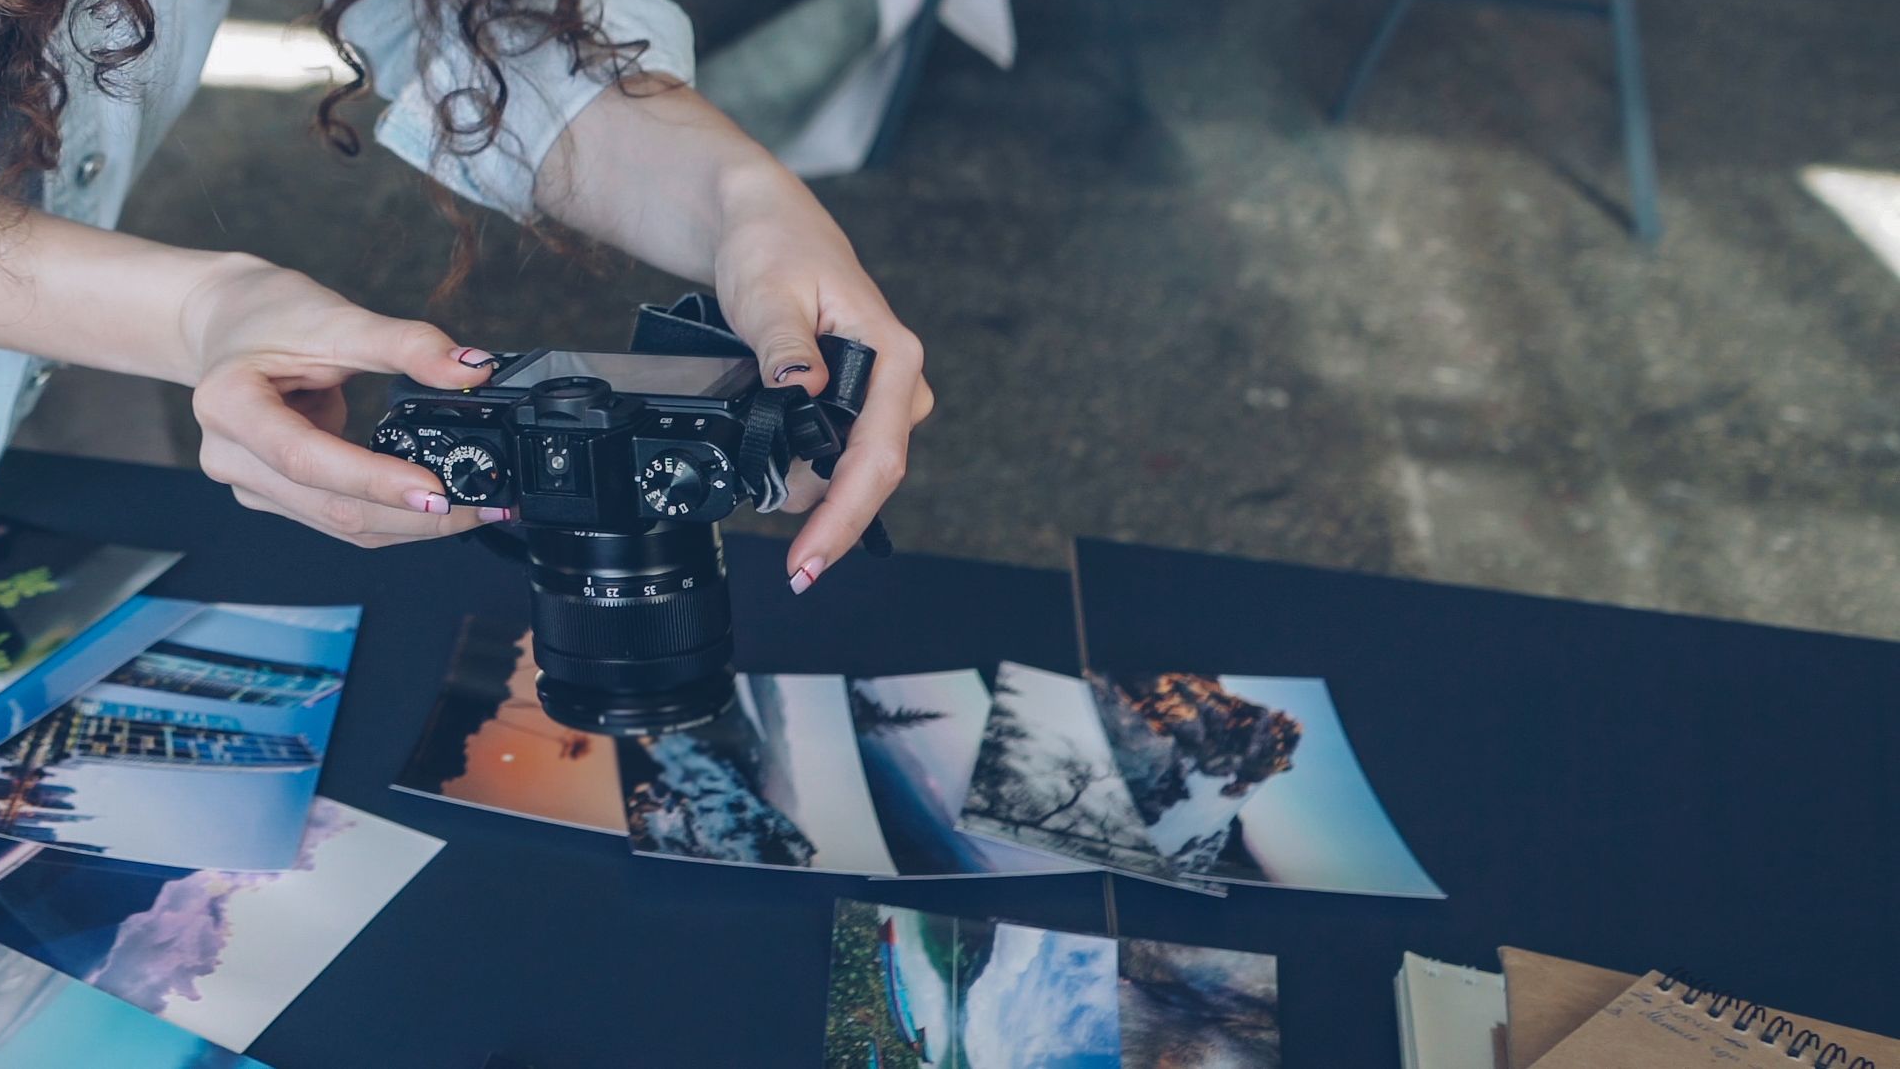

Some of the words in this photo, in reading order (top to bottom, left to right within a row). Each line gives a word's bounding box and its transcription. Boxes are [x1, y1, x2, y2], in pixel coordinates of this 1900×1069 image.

[682, 577, 694, 589] 50
[583, 587, 596, 597] 16
[606, 587, 620, 598] 23
[644, 585, 657, 596] 35
